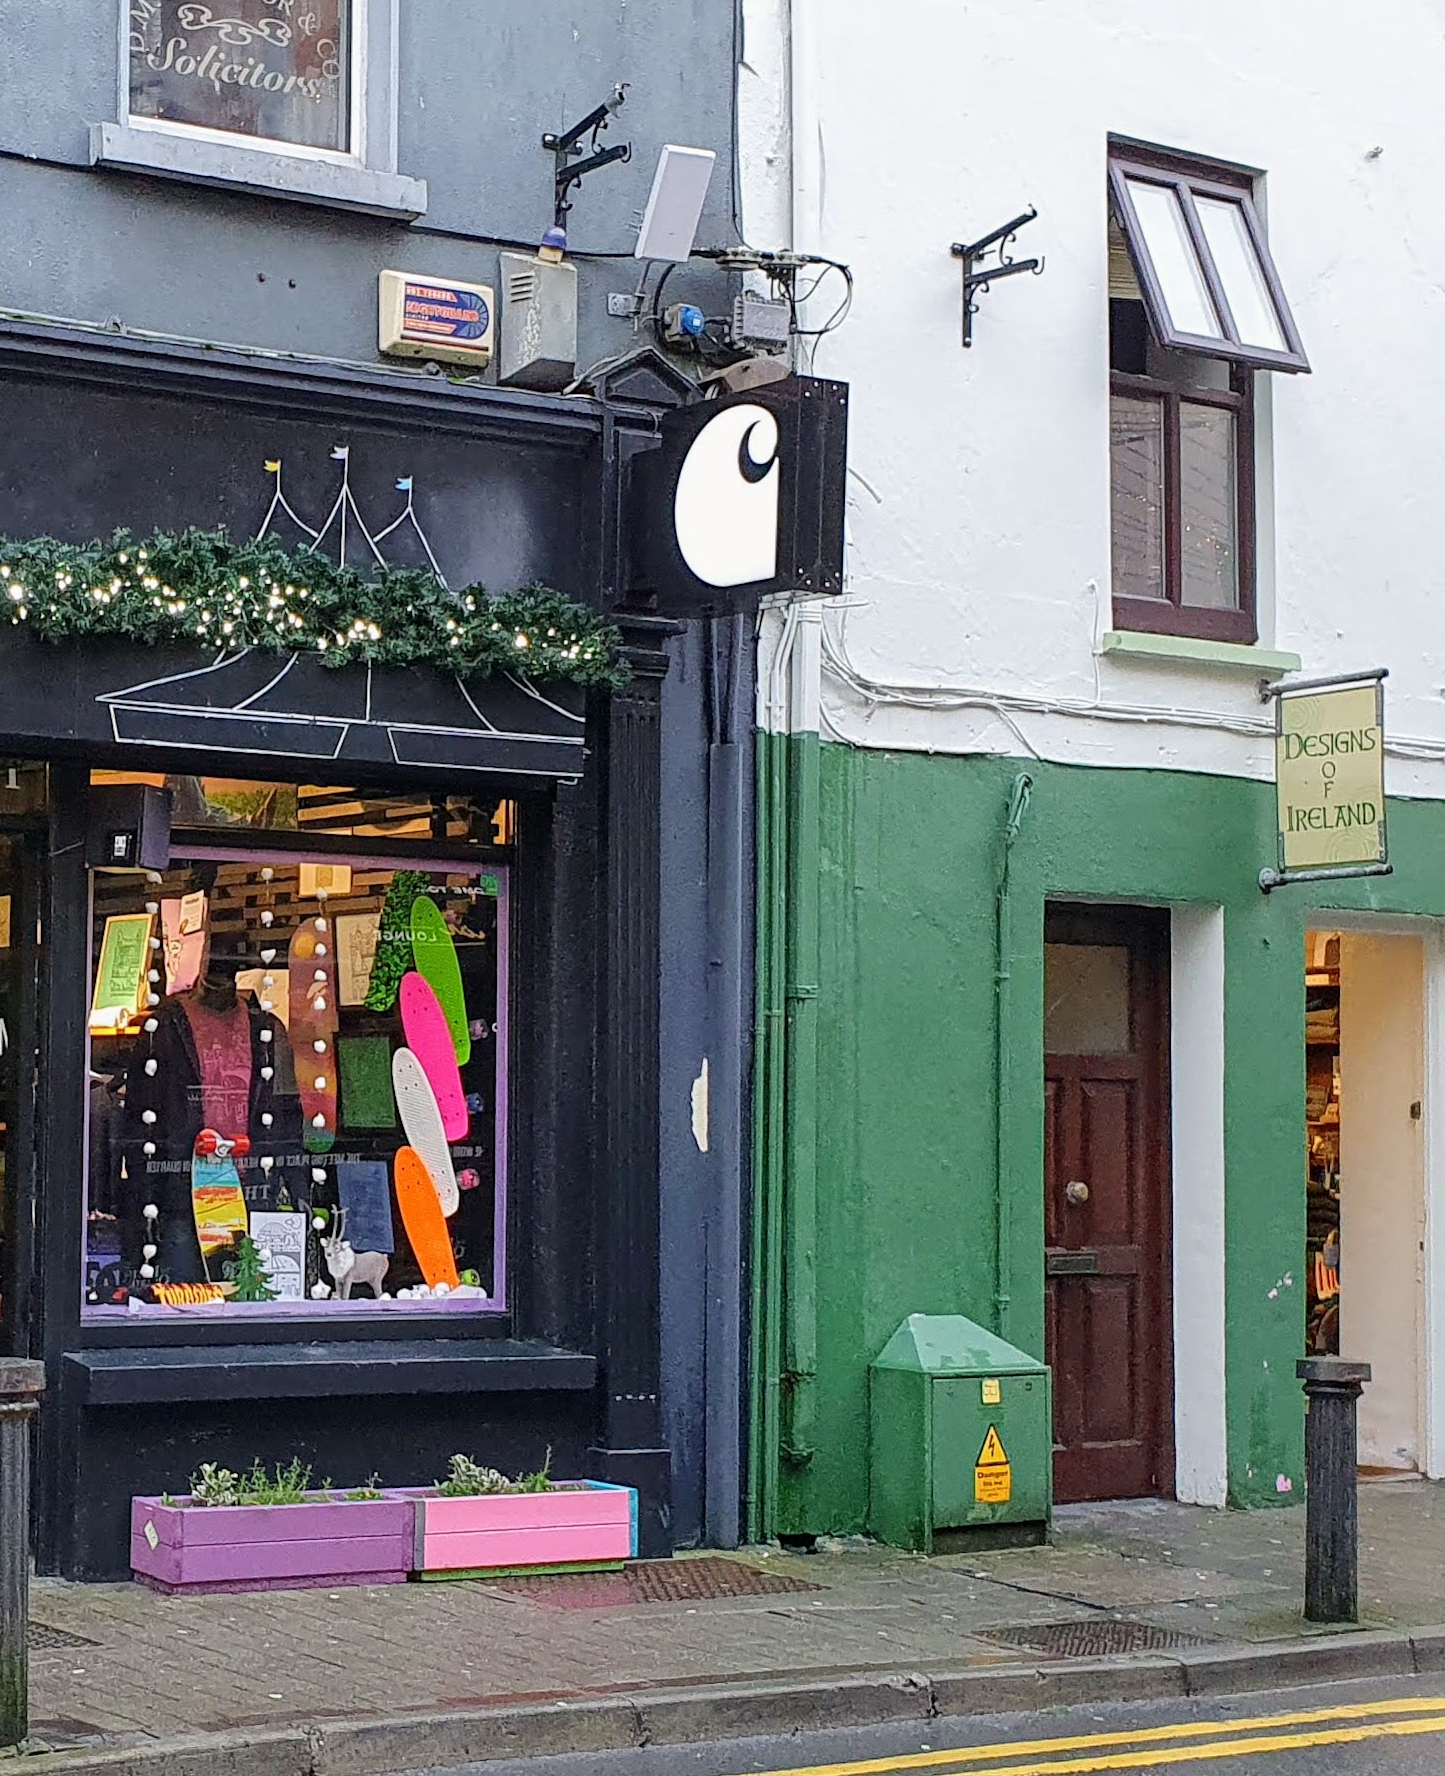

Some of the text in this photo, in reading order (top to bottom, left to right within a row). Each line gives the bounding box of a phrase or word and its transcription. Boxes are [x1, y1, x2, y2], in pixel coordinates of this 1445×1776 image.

[147, 37, 322, 97] Solicitors
[1284, 728, 1376, 760] DESIGNS
[1287, 802, 1376, 833] IRELAND
